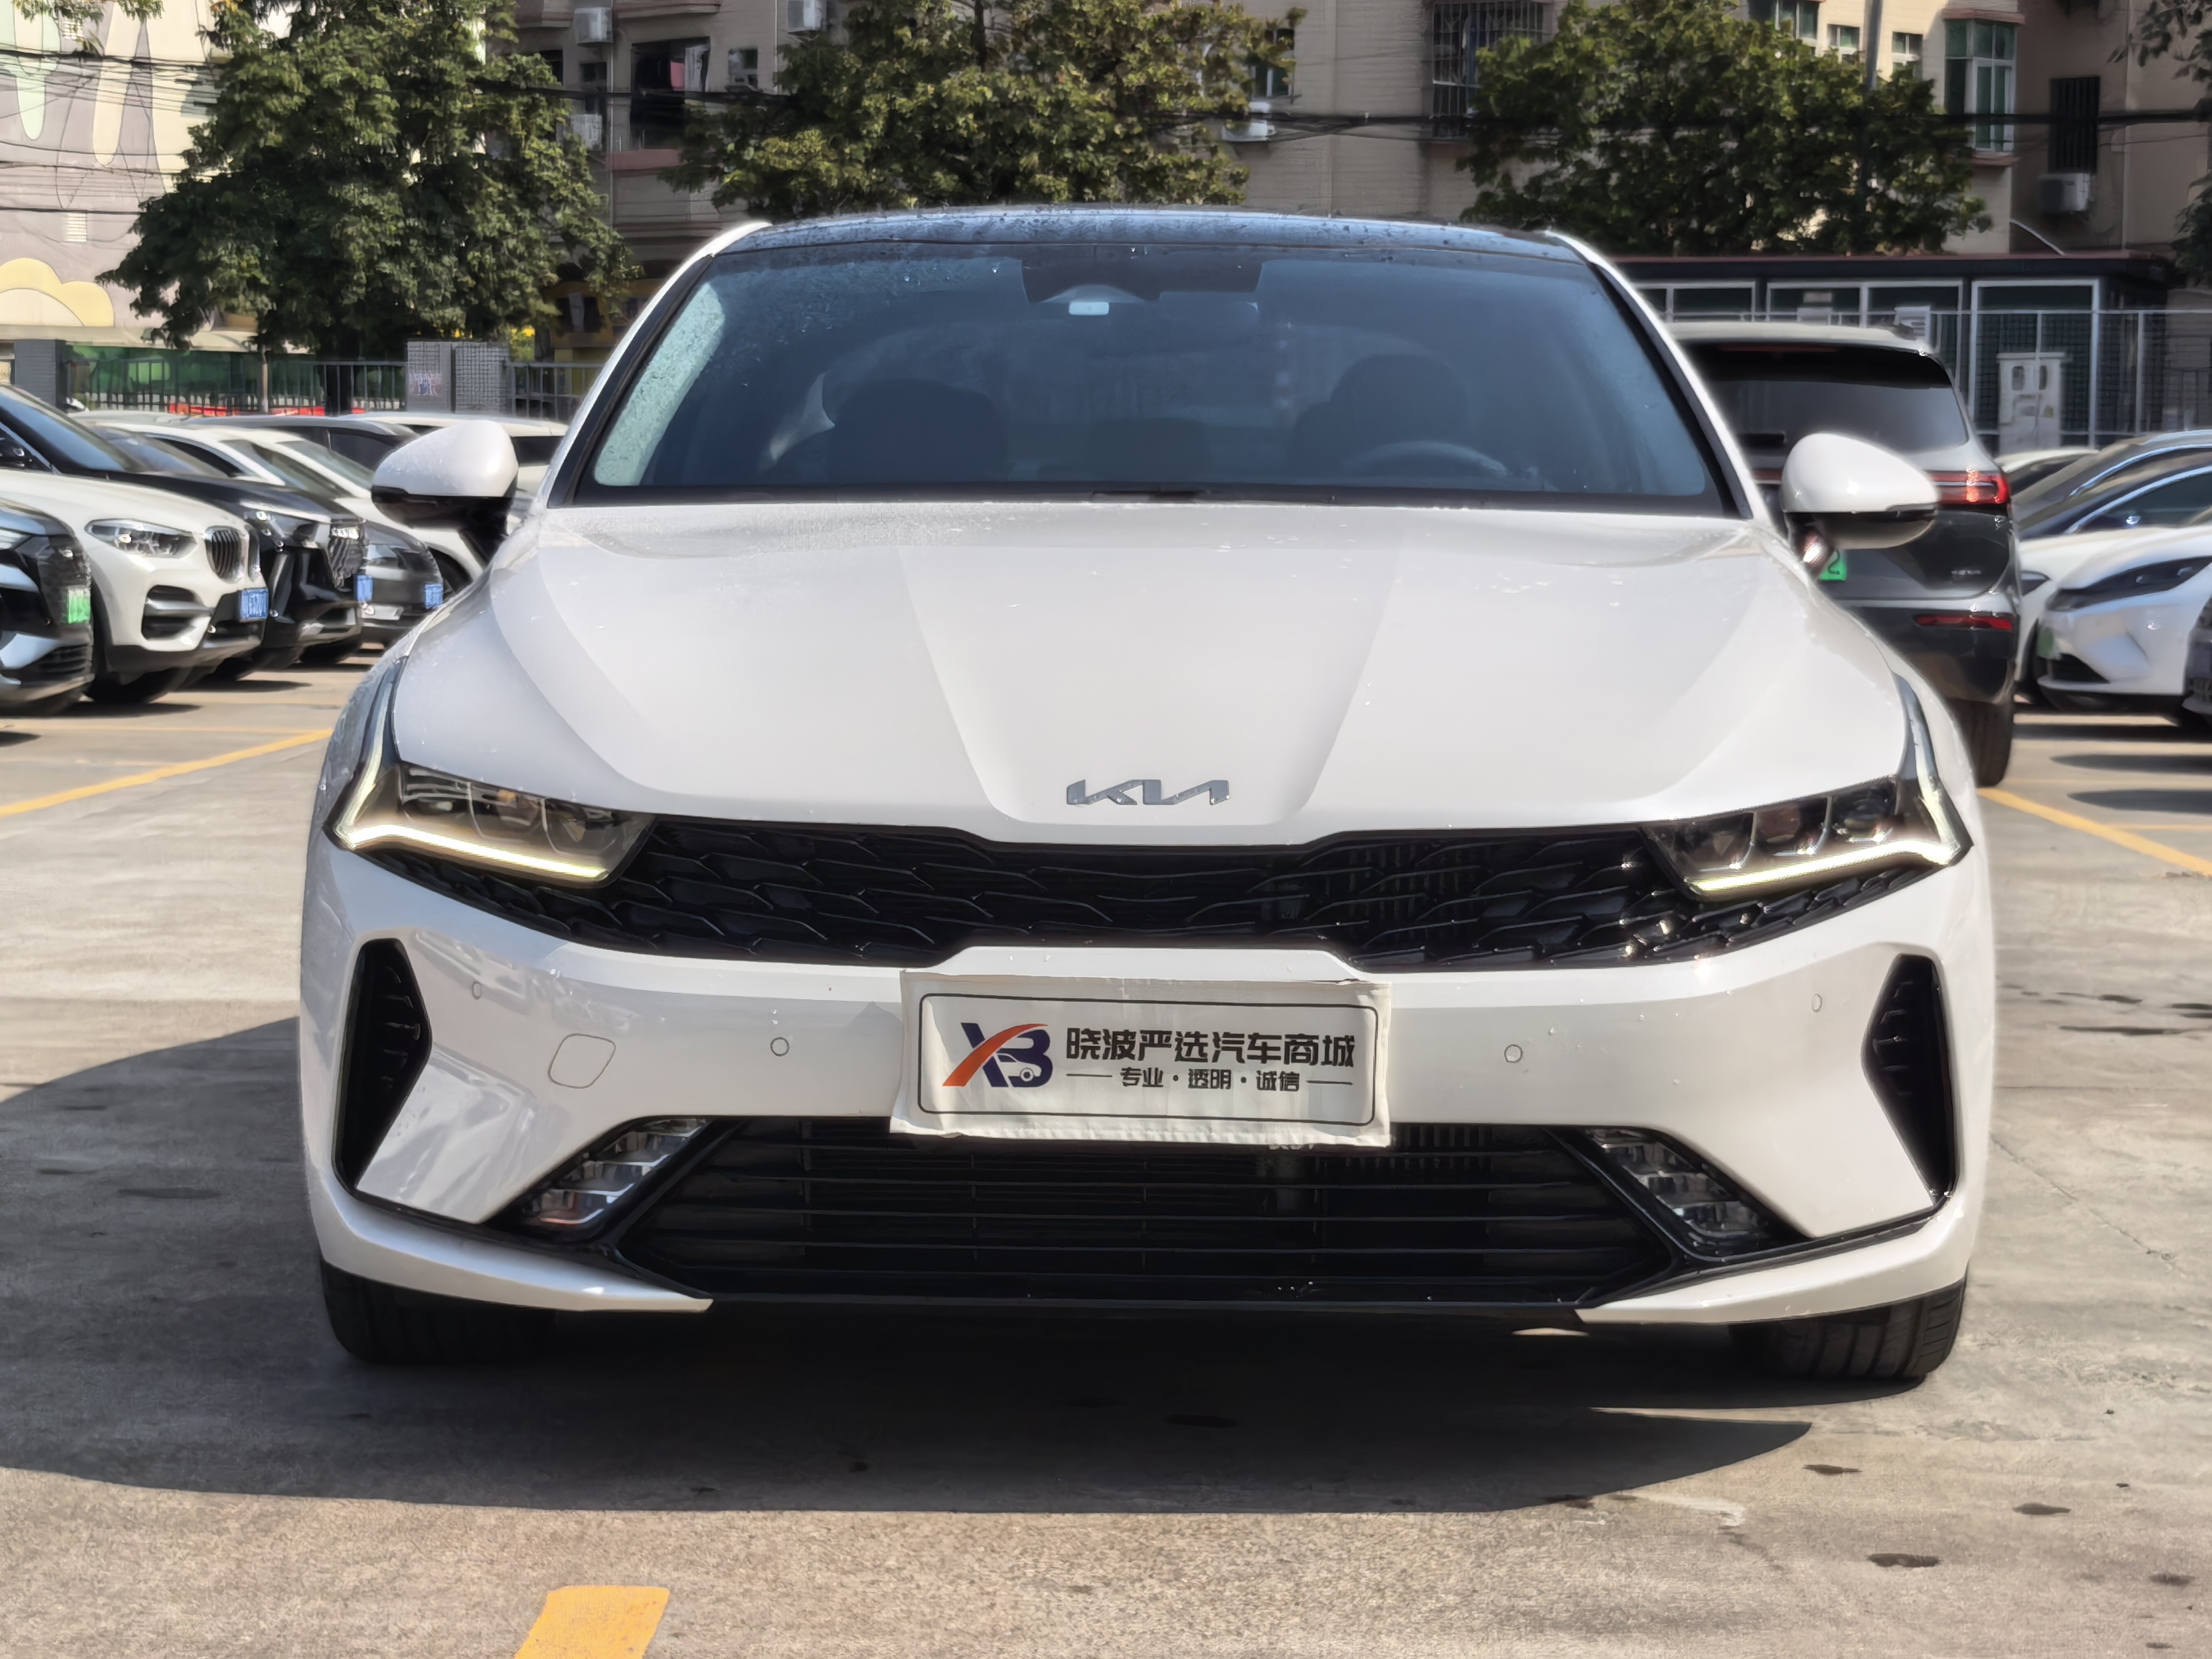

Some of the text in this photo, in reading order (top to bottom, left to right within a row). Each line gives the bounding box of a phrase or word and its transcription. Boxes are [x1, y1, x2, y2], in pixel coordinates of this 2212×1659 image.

[942, 1022, 1053, 1088] XB
[1065, 1028, 1355, 1068] 晓波严选汽车商城
